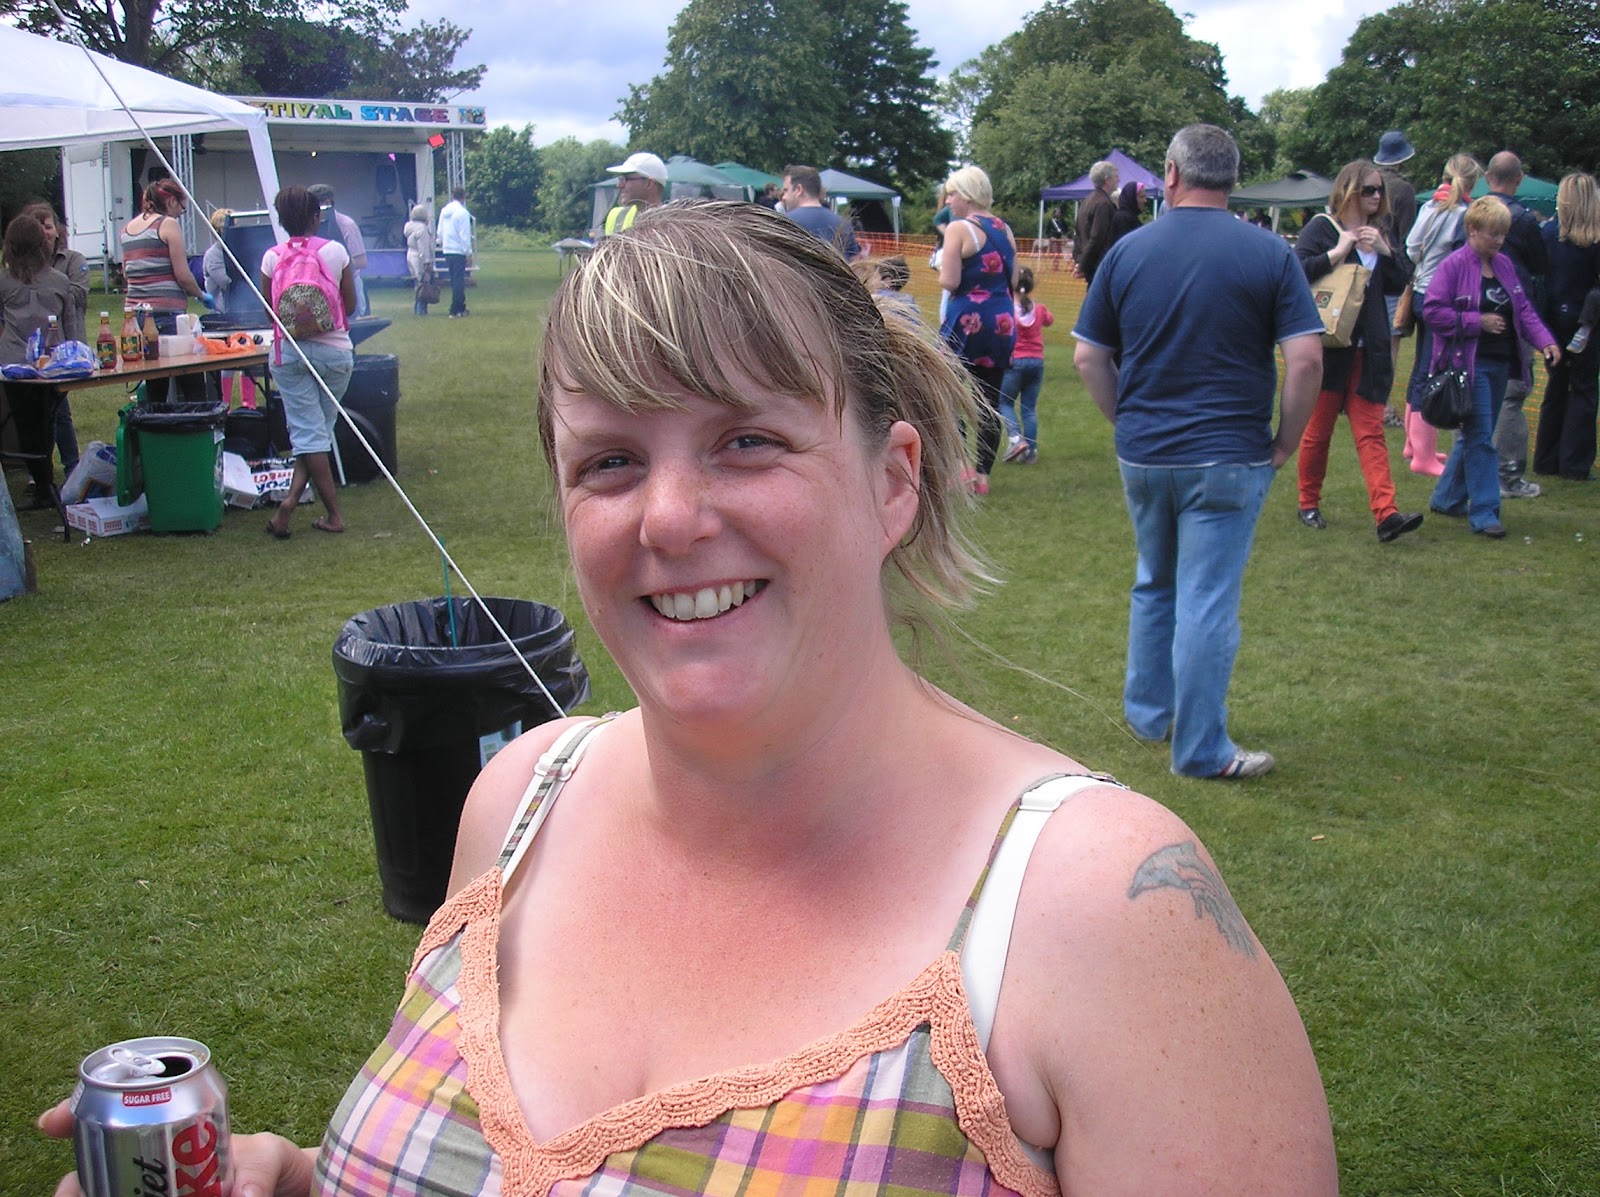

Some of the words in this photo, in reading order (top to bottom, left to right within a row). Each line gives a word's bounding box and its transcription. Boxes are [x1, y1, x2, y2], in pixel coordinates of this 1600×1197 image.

[360, 105, 450, 123] STAGE
[124, 1095, 151, 1105] SUGAR
[151, 1091, 171, 1103] FREE
